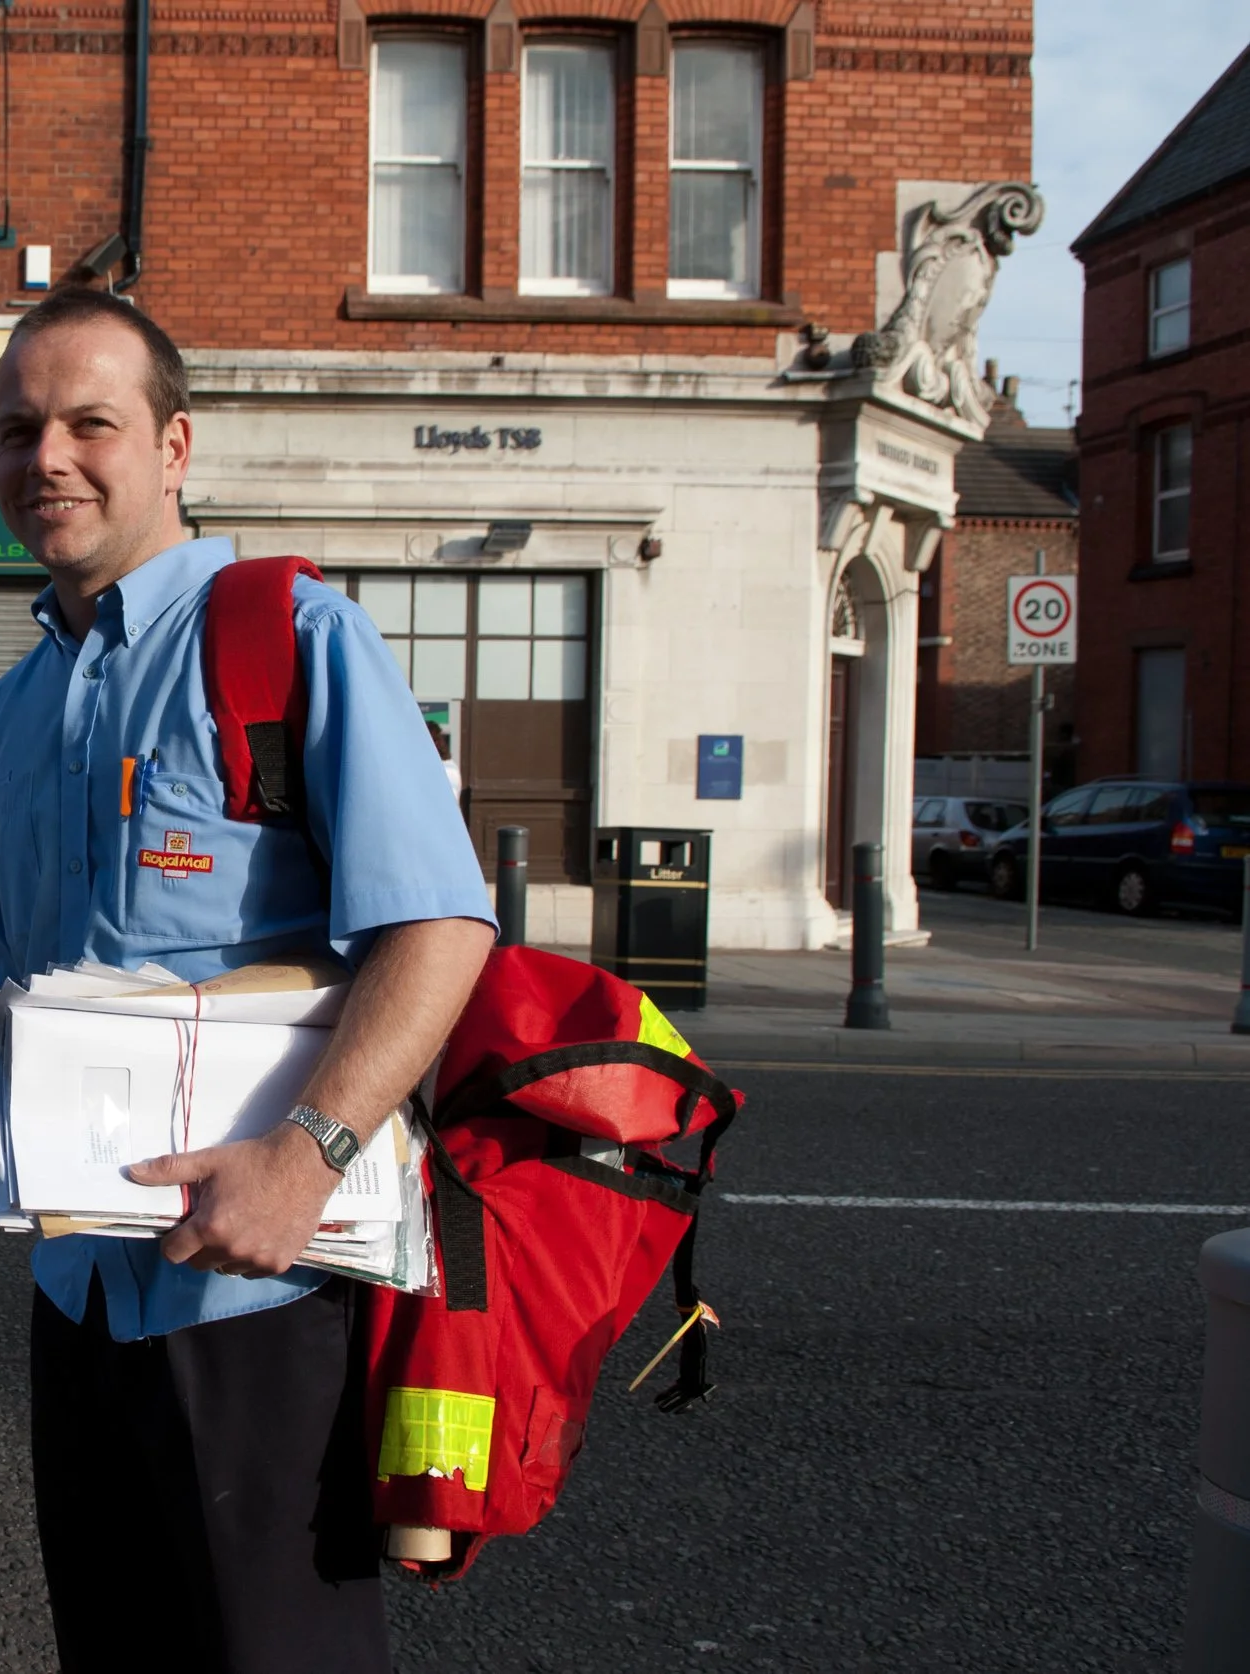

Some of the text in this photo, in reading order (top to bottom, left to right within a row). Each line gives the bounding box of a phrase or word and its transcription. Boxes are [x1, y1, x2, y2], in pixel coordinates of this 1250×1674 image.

[414, 424, 542, 455] Lloyds TSB
[1025, 599, 1062, 620] 20
[1014, 642, 1068, 657] ZONE
[142, 851, 211, 870] Royal Mail
[651, 868, 684, 880] Litter
